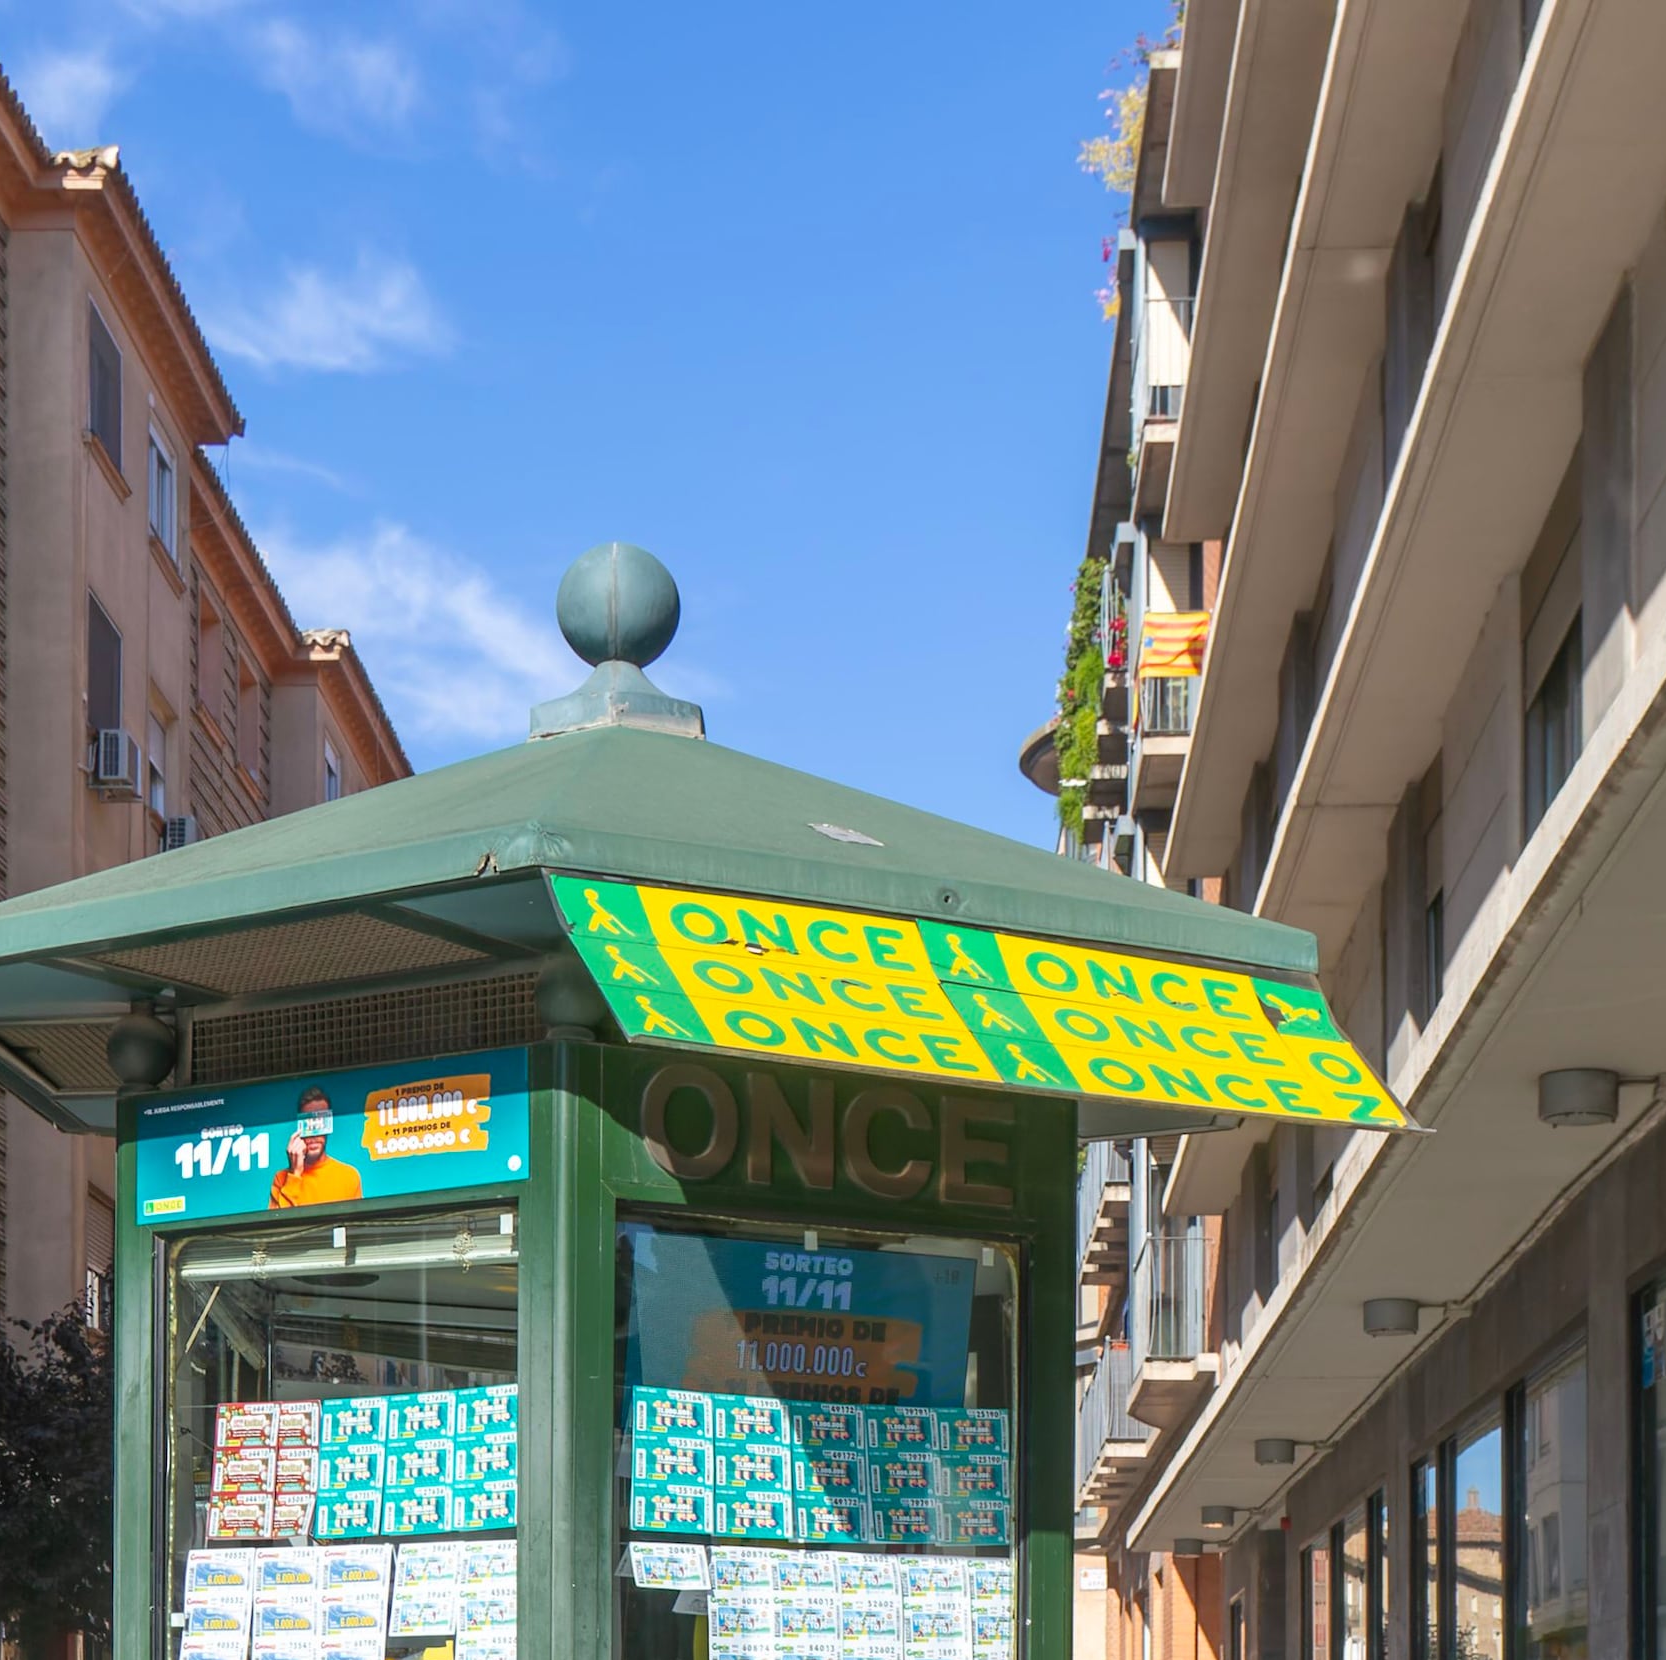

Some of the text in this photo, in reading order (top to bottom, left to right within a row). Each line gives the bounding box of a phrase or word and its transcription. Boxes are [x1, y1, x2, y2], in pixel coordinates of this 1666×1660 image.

[670, 901, 1253, 1022] ONCE ONCE
[691, 958, 1286, 1065] ONCE ONCE
[723, 1008, 1323, 1115] ONCE ONCE
[375, 1130, 456, 1155] 1.000.000
[403, 1123, 438, 1133] PREMIOS
[440, 1121, 450, 1129] DE
[642, 1061, 1017, 1206] ONCE
[175, 1132, 270, 1179] 11/11
[765, 1252, 854, 1276] SORTEO
[762, 1275, 853, 1311] 11/11
[744, 1312, 887, 1343] PREMIO DE
